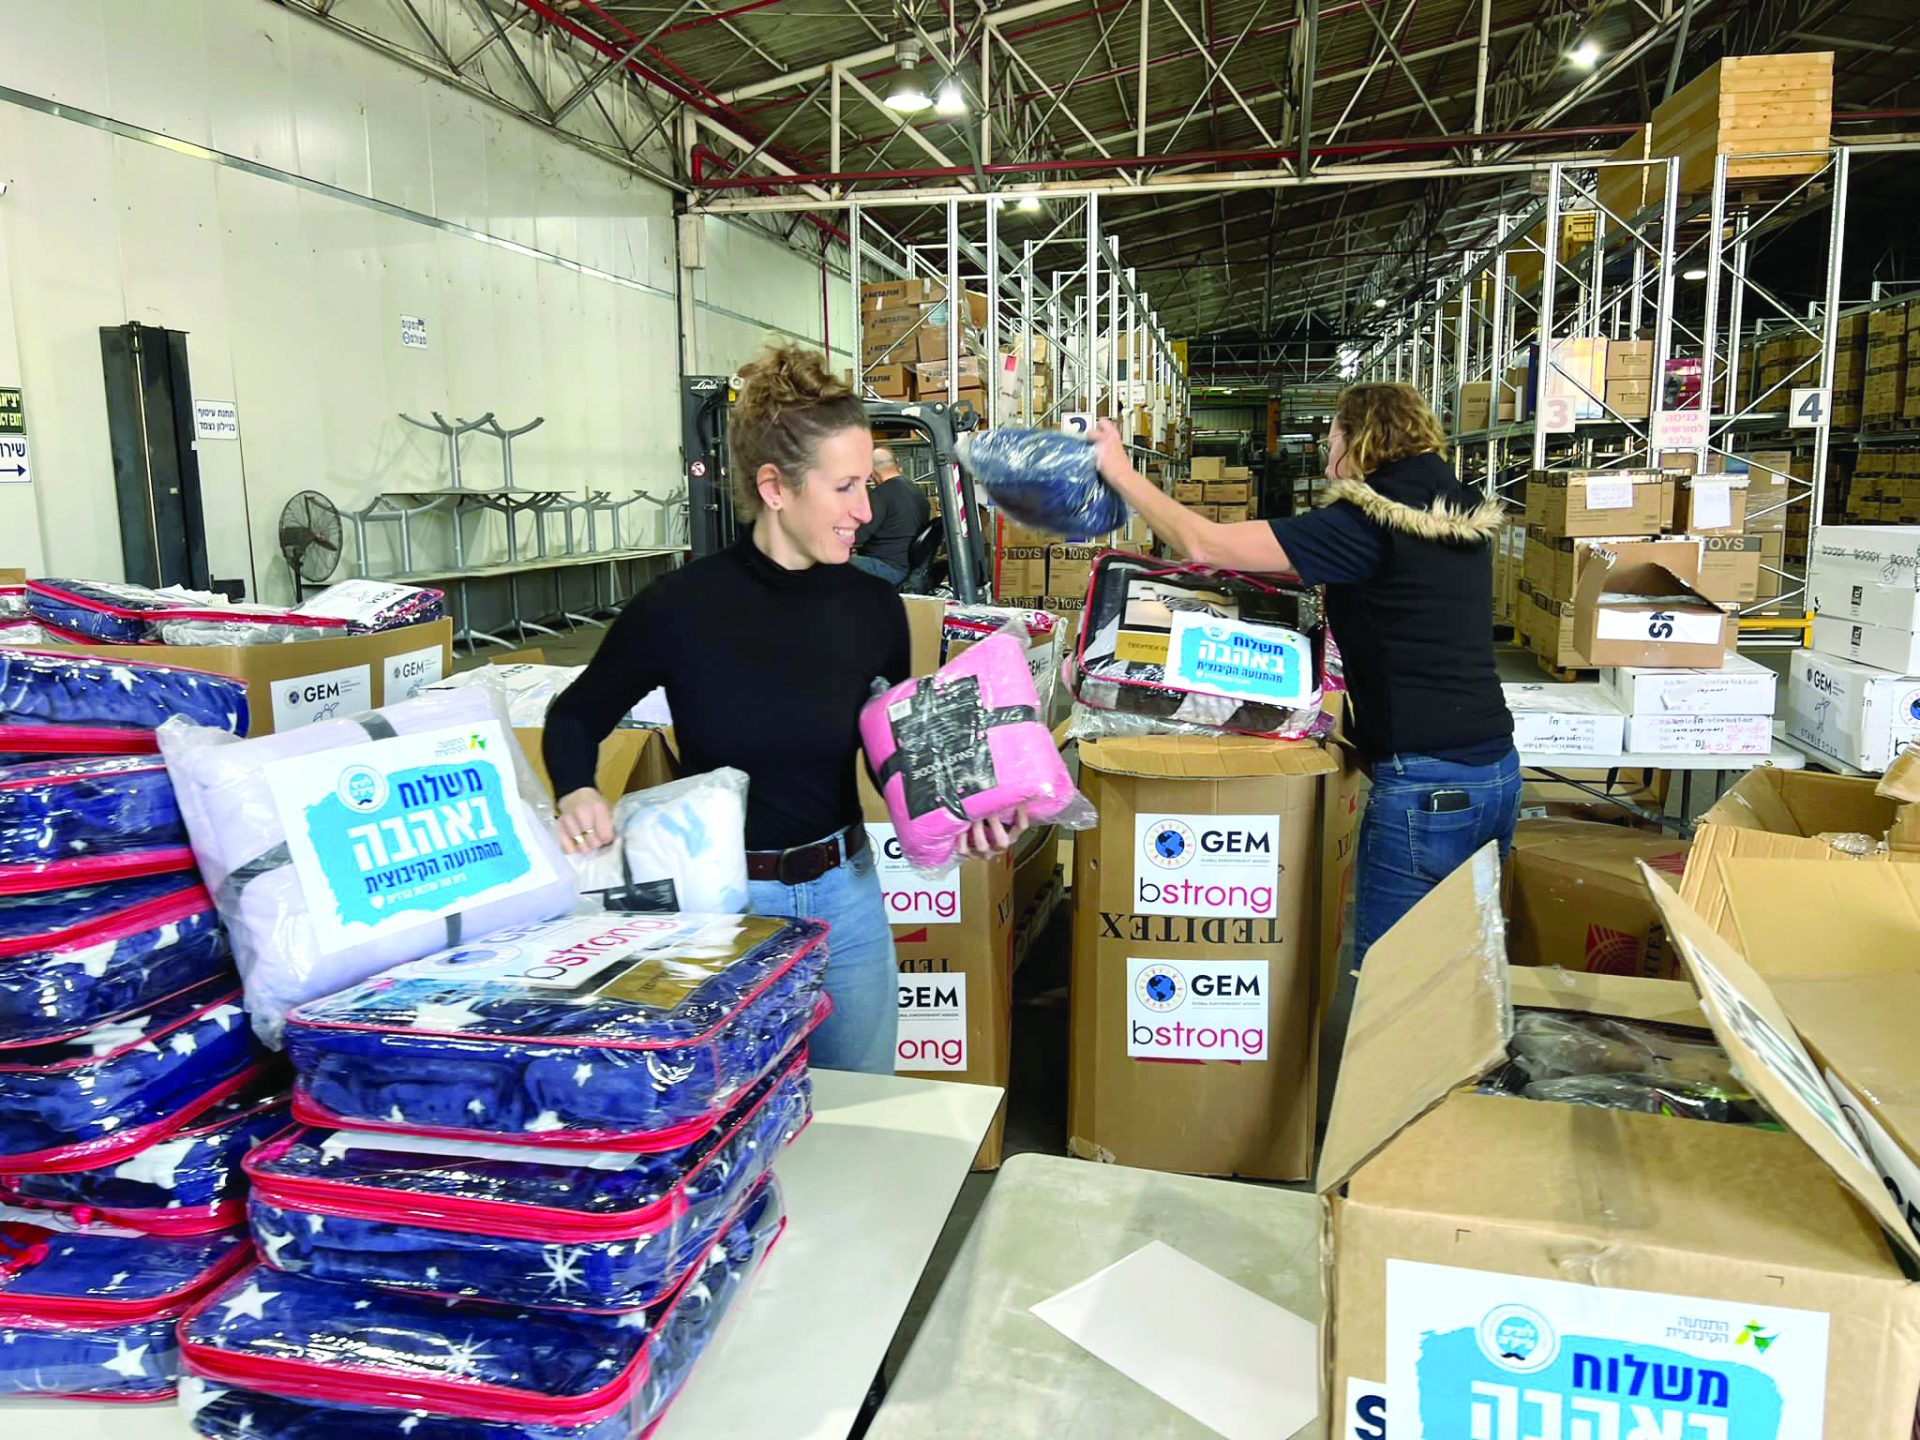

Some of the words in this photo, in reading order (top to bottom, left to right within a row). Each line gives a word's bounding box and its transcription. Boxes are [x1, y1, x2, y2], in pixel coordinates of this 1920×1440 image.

[1544, 400, 1569, 429] 3
[1798, 393, 1823, 422] 4
[1013, 548, 1041, 559] TOYS
[1068, 548, 1090, 559] TOYS
[1702, 537, 1745, 551] TOYS
[1061, 599, 1083, 609] TOYS
[1199, 641, 1286, 674] באהבה
[1233, 635, 1284, 655] משלוח
[402, 660, 425, 678] GEM
[1197, 660, 1239, 677] הקיבוצית
[303, 682, 340, 703] GEM
[1814, 670, 1832, 695] GEM
[397, 768, 483, 808] משלוח
[348, 796, 499, 873] באהבה
[1201, 830, 1270, 853] GEM
[442, 841, 503, 870] מהתנועה
[364, 858, 440, 894] הקיבוצית
[881, 890, 956, 918] rong
[1139, 877, 1272, 914] bstrong
[1098, 912, 1283, 944] TEDITEX
[504, 917, 678, 981] bstrong
[898, 986, 959, 1008] GEM
[1191, 974, 1260, 997] GEM
[1132, 1019, 1263, 1055] bstrong
[898, 1039, 963, 1066] ong
[1572, 1353, 1729, 1409] משלוח
